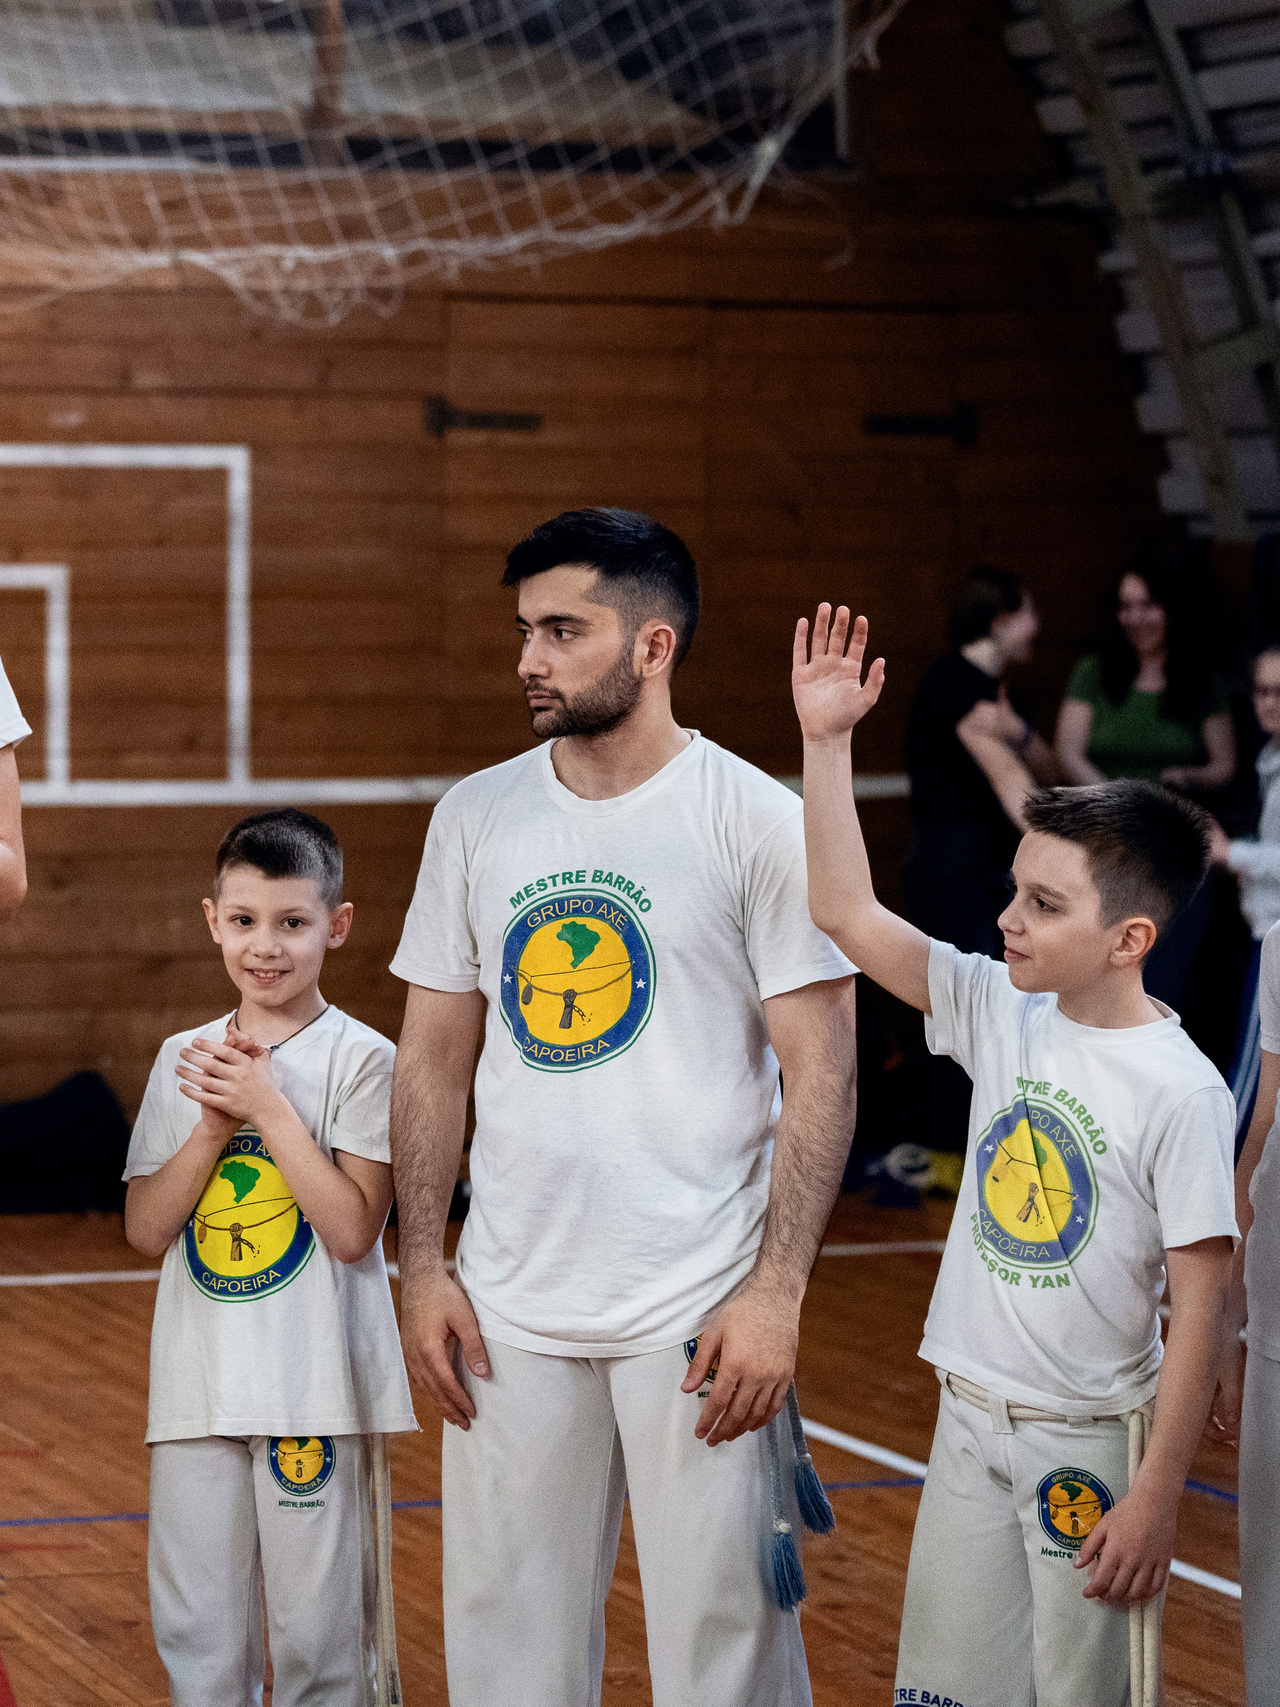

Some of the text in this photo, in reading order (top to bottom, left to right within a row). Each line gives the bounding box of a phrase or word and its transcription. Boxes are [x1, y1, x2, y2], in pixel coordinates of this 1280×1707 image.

[509, 870, 652, 912] MESTRE BARRÃO
[527, 899, 628, 931] GRUPO AXÉ
[522, 1036, 610, 1062] CAPOEIRA
[1053, 1088, 1108, 1155] BARRÃO
[979, 1208, 1050, 1258] CAPOEIRA
[202, 1270, 281, 1292] CAPOEIRA
[1028, 1272, 1070, 1289] YAN
[281, 1477, 322, 1491] CAPOEIRA
[1051, 1472, 1074, 1483] GRUPO
[1041, 1546, 1073, 1559] Mestre
